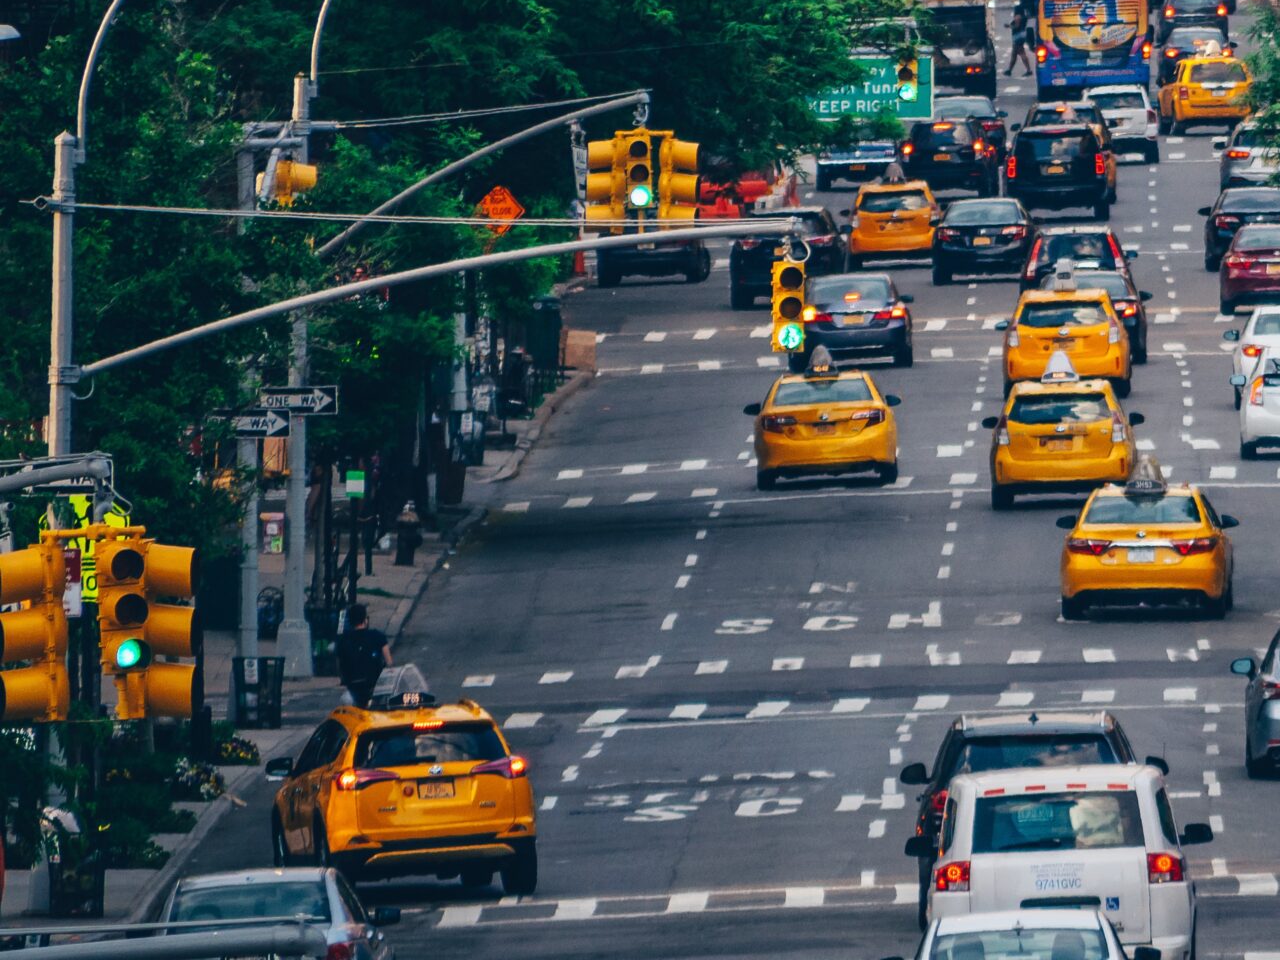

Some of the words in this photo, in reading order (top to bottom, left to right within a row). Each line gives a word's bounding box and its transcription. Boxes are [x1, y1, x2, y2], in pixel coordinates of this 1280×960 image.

[863, 82, 899, 94] Tunn
[809, 100, 850, 113] KEEP
[266, 395, 290, 406] ONE
[300, 394, 325, 406] WAY
[250, 417, 277, 428] WAY
[70, 476, 93, 485] WA
[1035, 879, 1082, 890] 9741GVC
